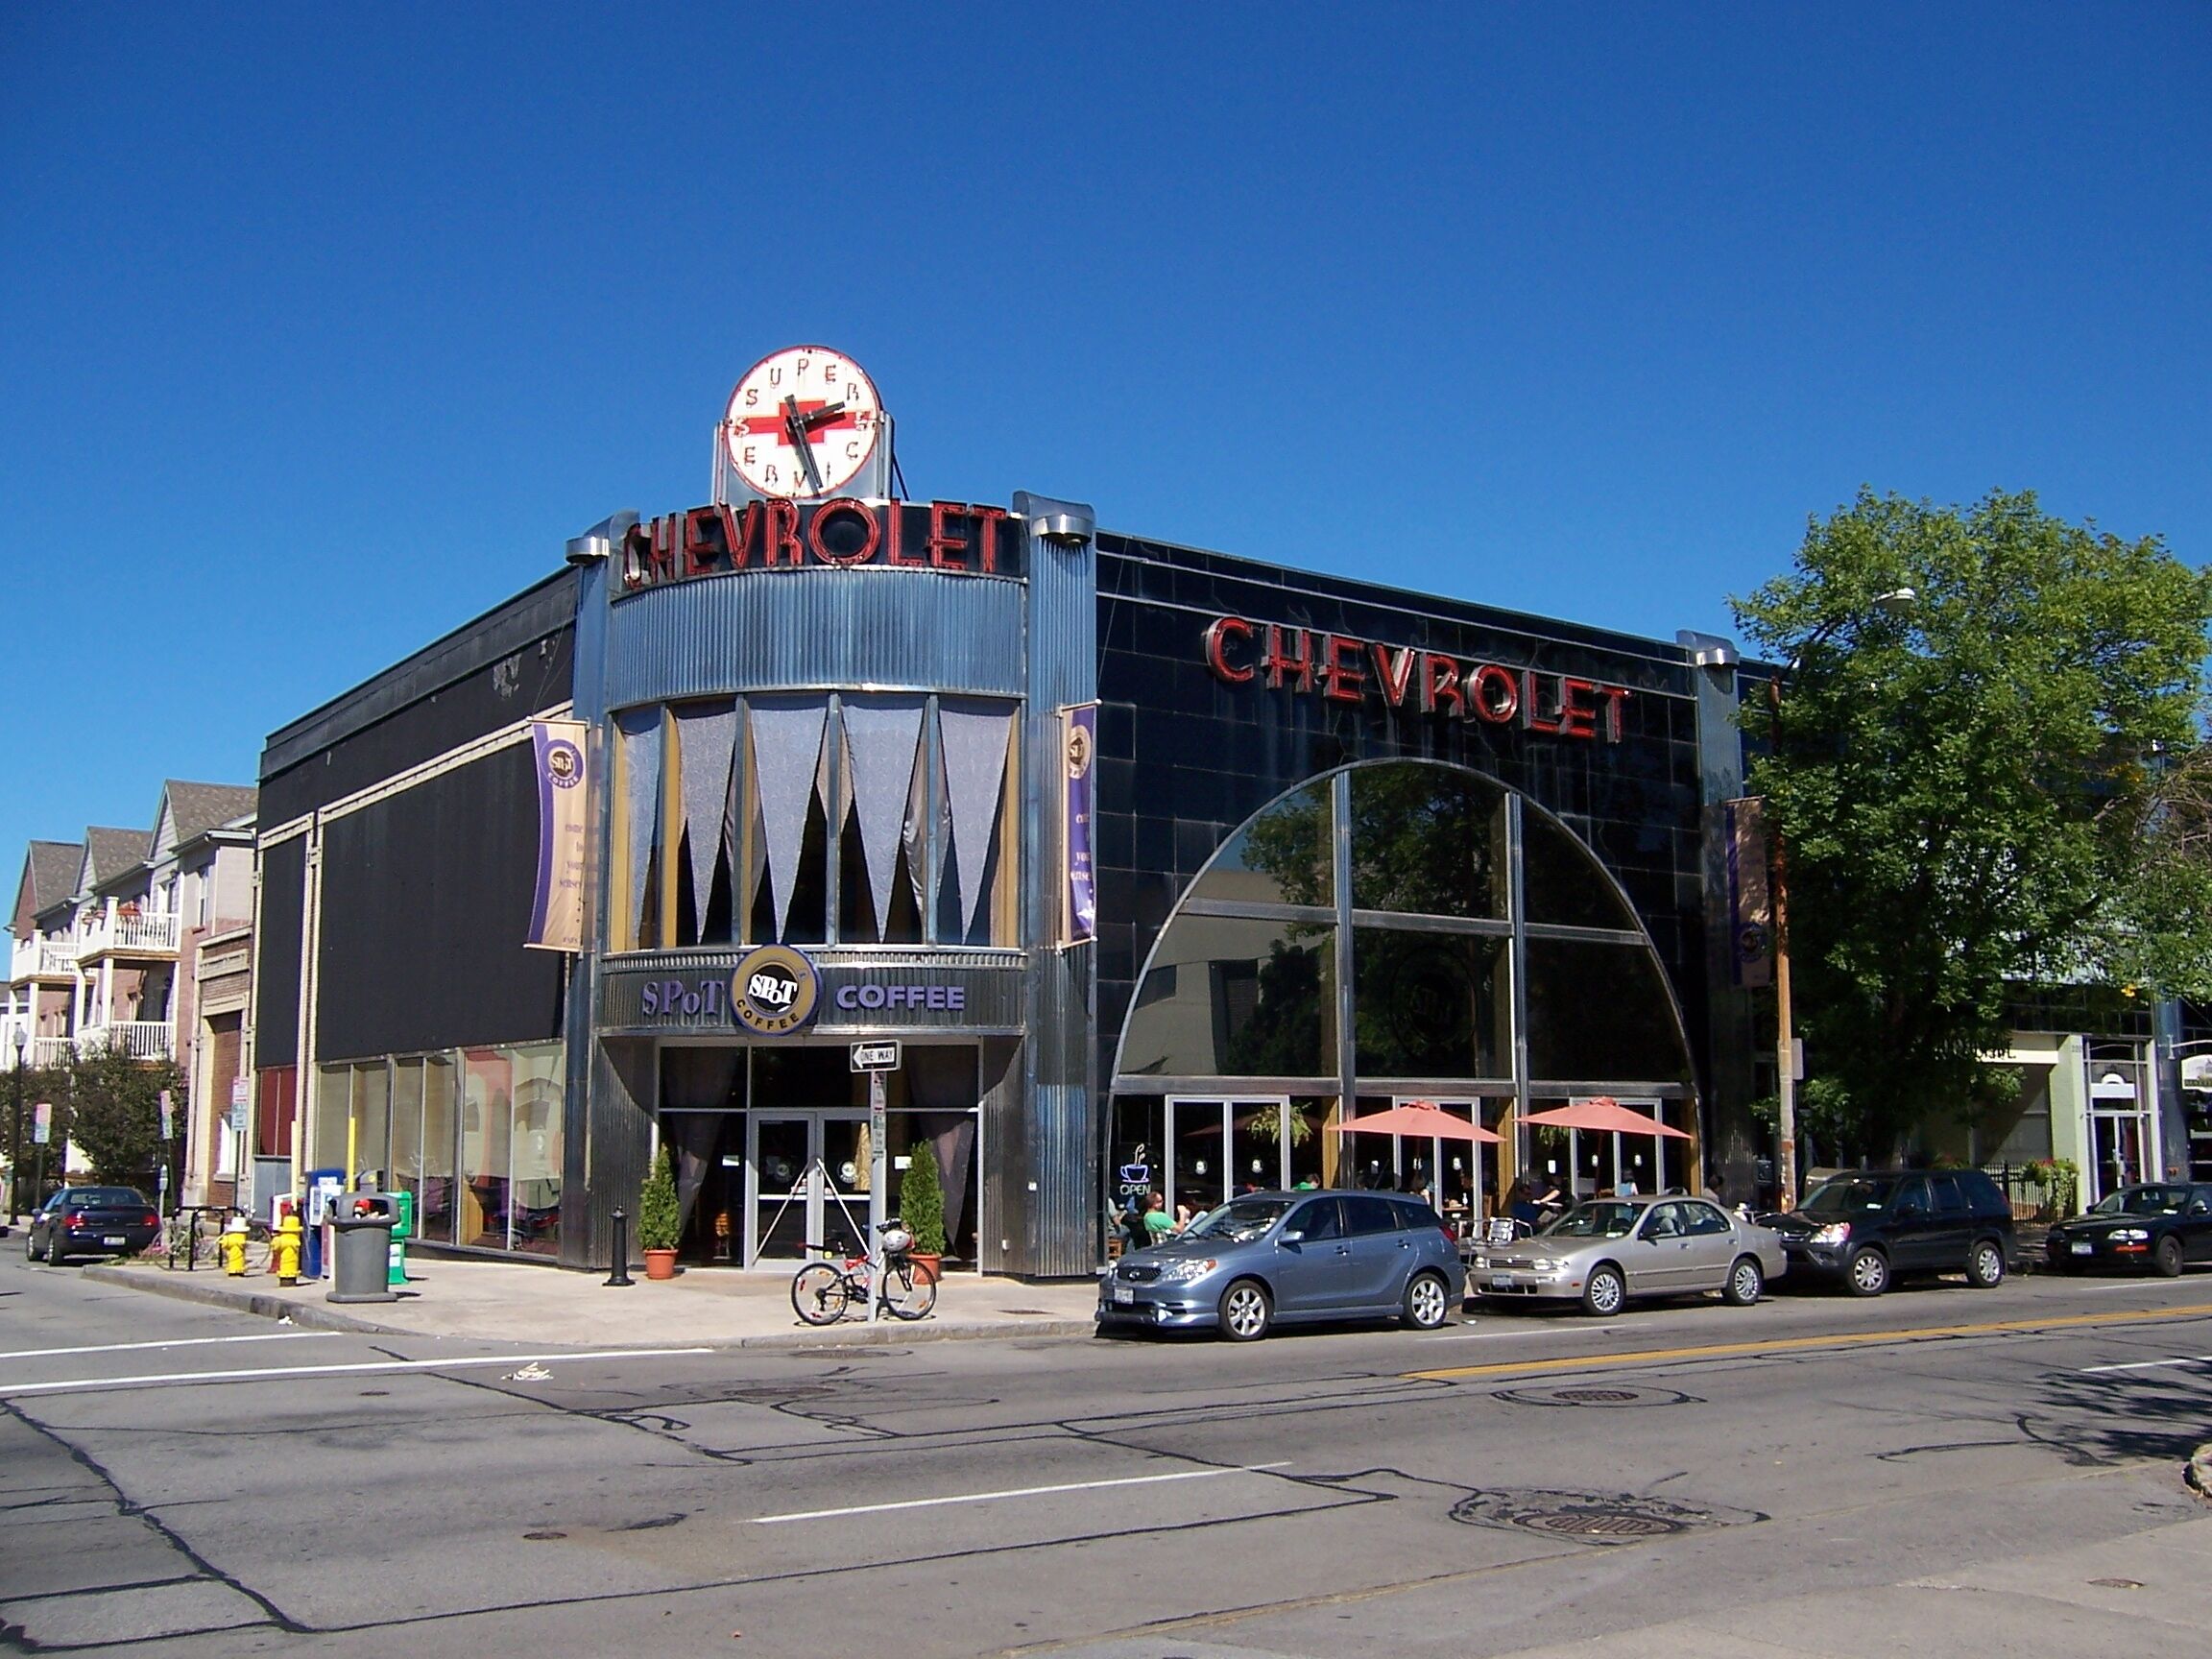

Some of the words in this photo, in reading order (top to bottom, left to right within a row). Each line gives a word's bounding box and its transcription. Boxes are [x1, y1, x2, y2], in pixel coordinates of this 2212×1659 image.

[745, 358, 860, 408] SUPER
[733, 411, 873, 489] SERVICE
[622, 497, 1008, 588] CHEVROLET
[1203, 615, 1631, 744] CHEVROLET
[736, 998, 800, 1030] COFFEE
[836, 985, 966, 1010] COFFEE
[860, 1050, 875, 1062] ONE
[877, 1048, 893, 1061] WAY
[1119, 1184, 1151, 1195] OPEN
